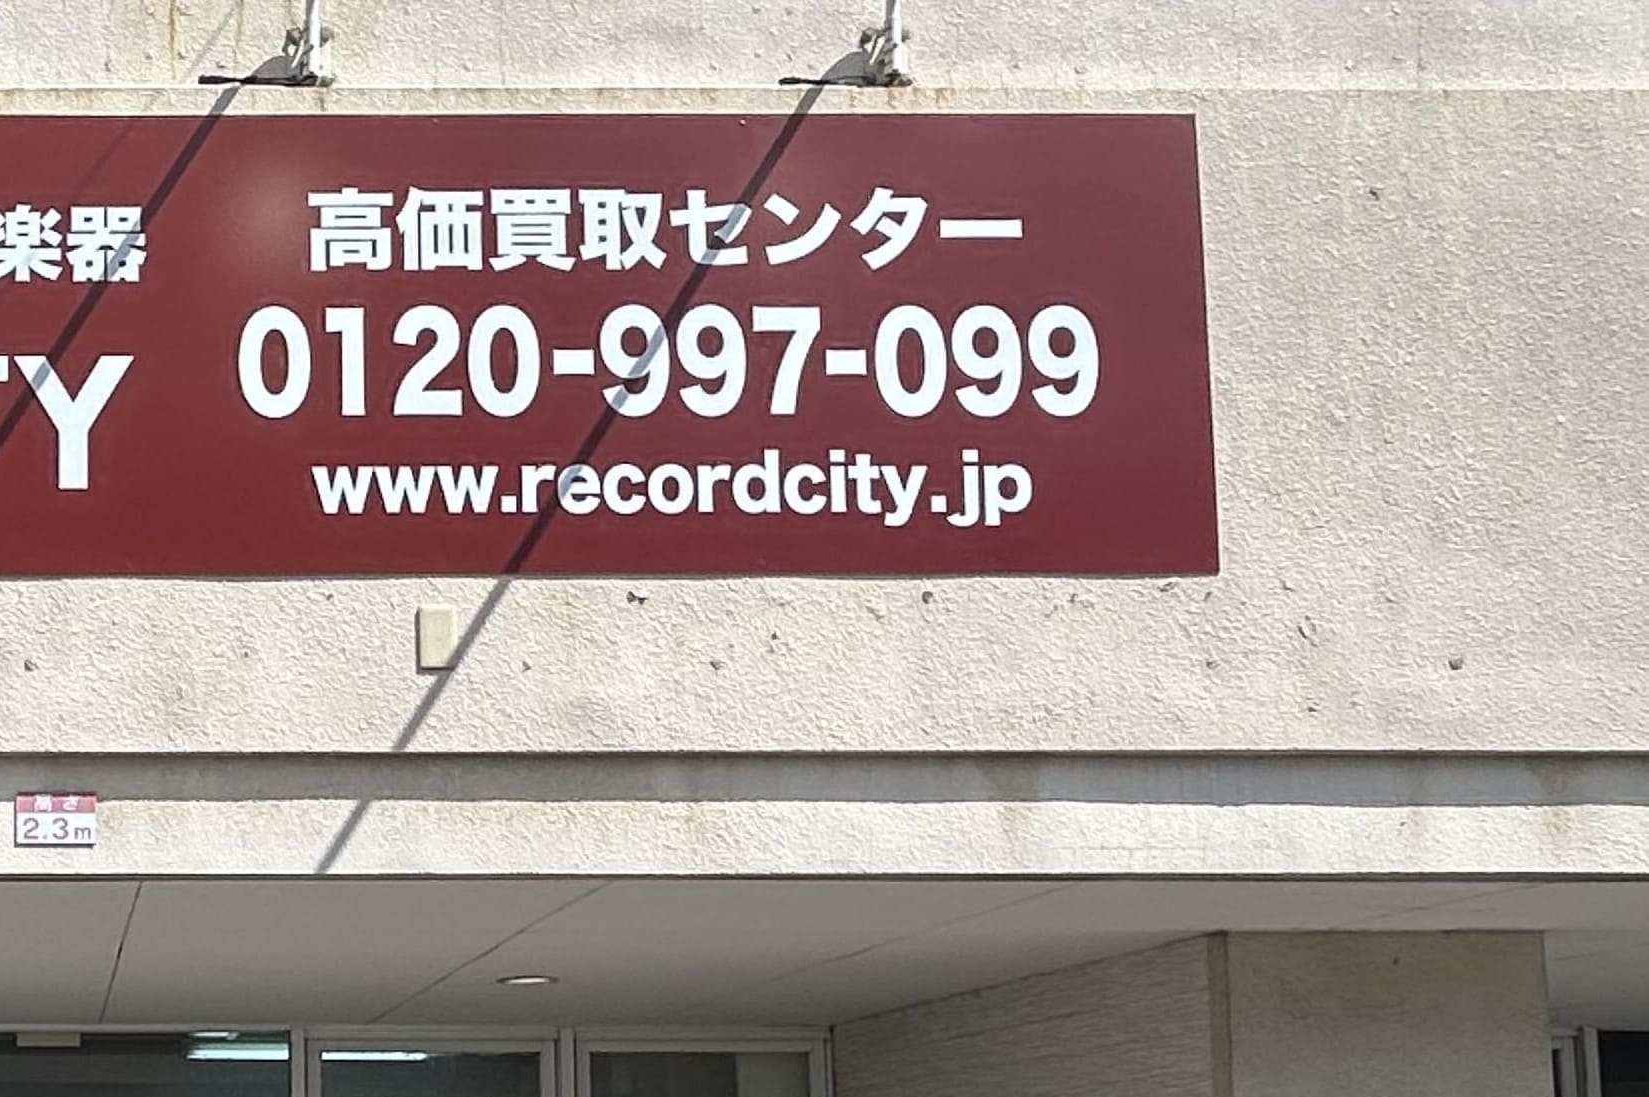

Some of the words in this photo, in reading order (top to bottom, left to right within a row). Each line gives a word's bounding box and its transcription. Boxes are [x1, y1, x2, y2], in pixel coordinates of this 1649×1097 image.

[307, 186, 1024, 272] 高価買取センター
[237, 303, 1100, 420] 0120-997-099
[311, 448, 1034, 527] www.recordcity.jp
